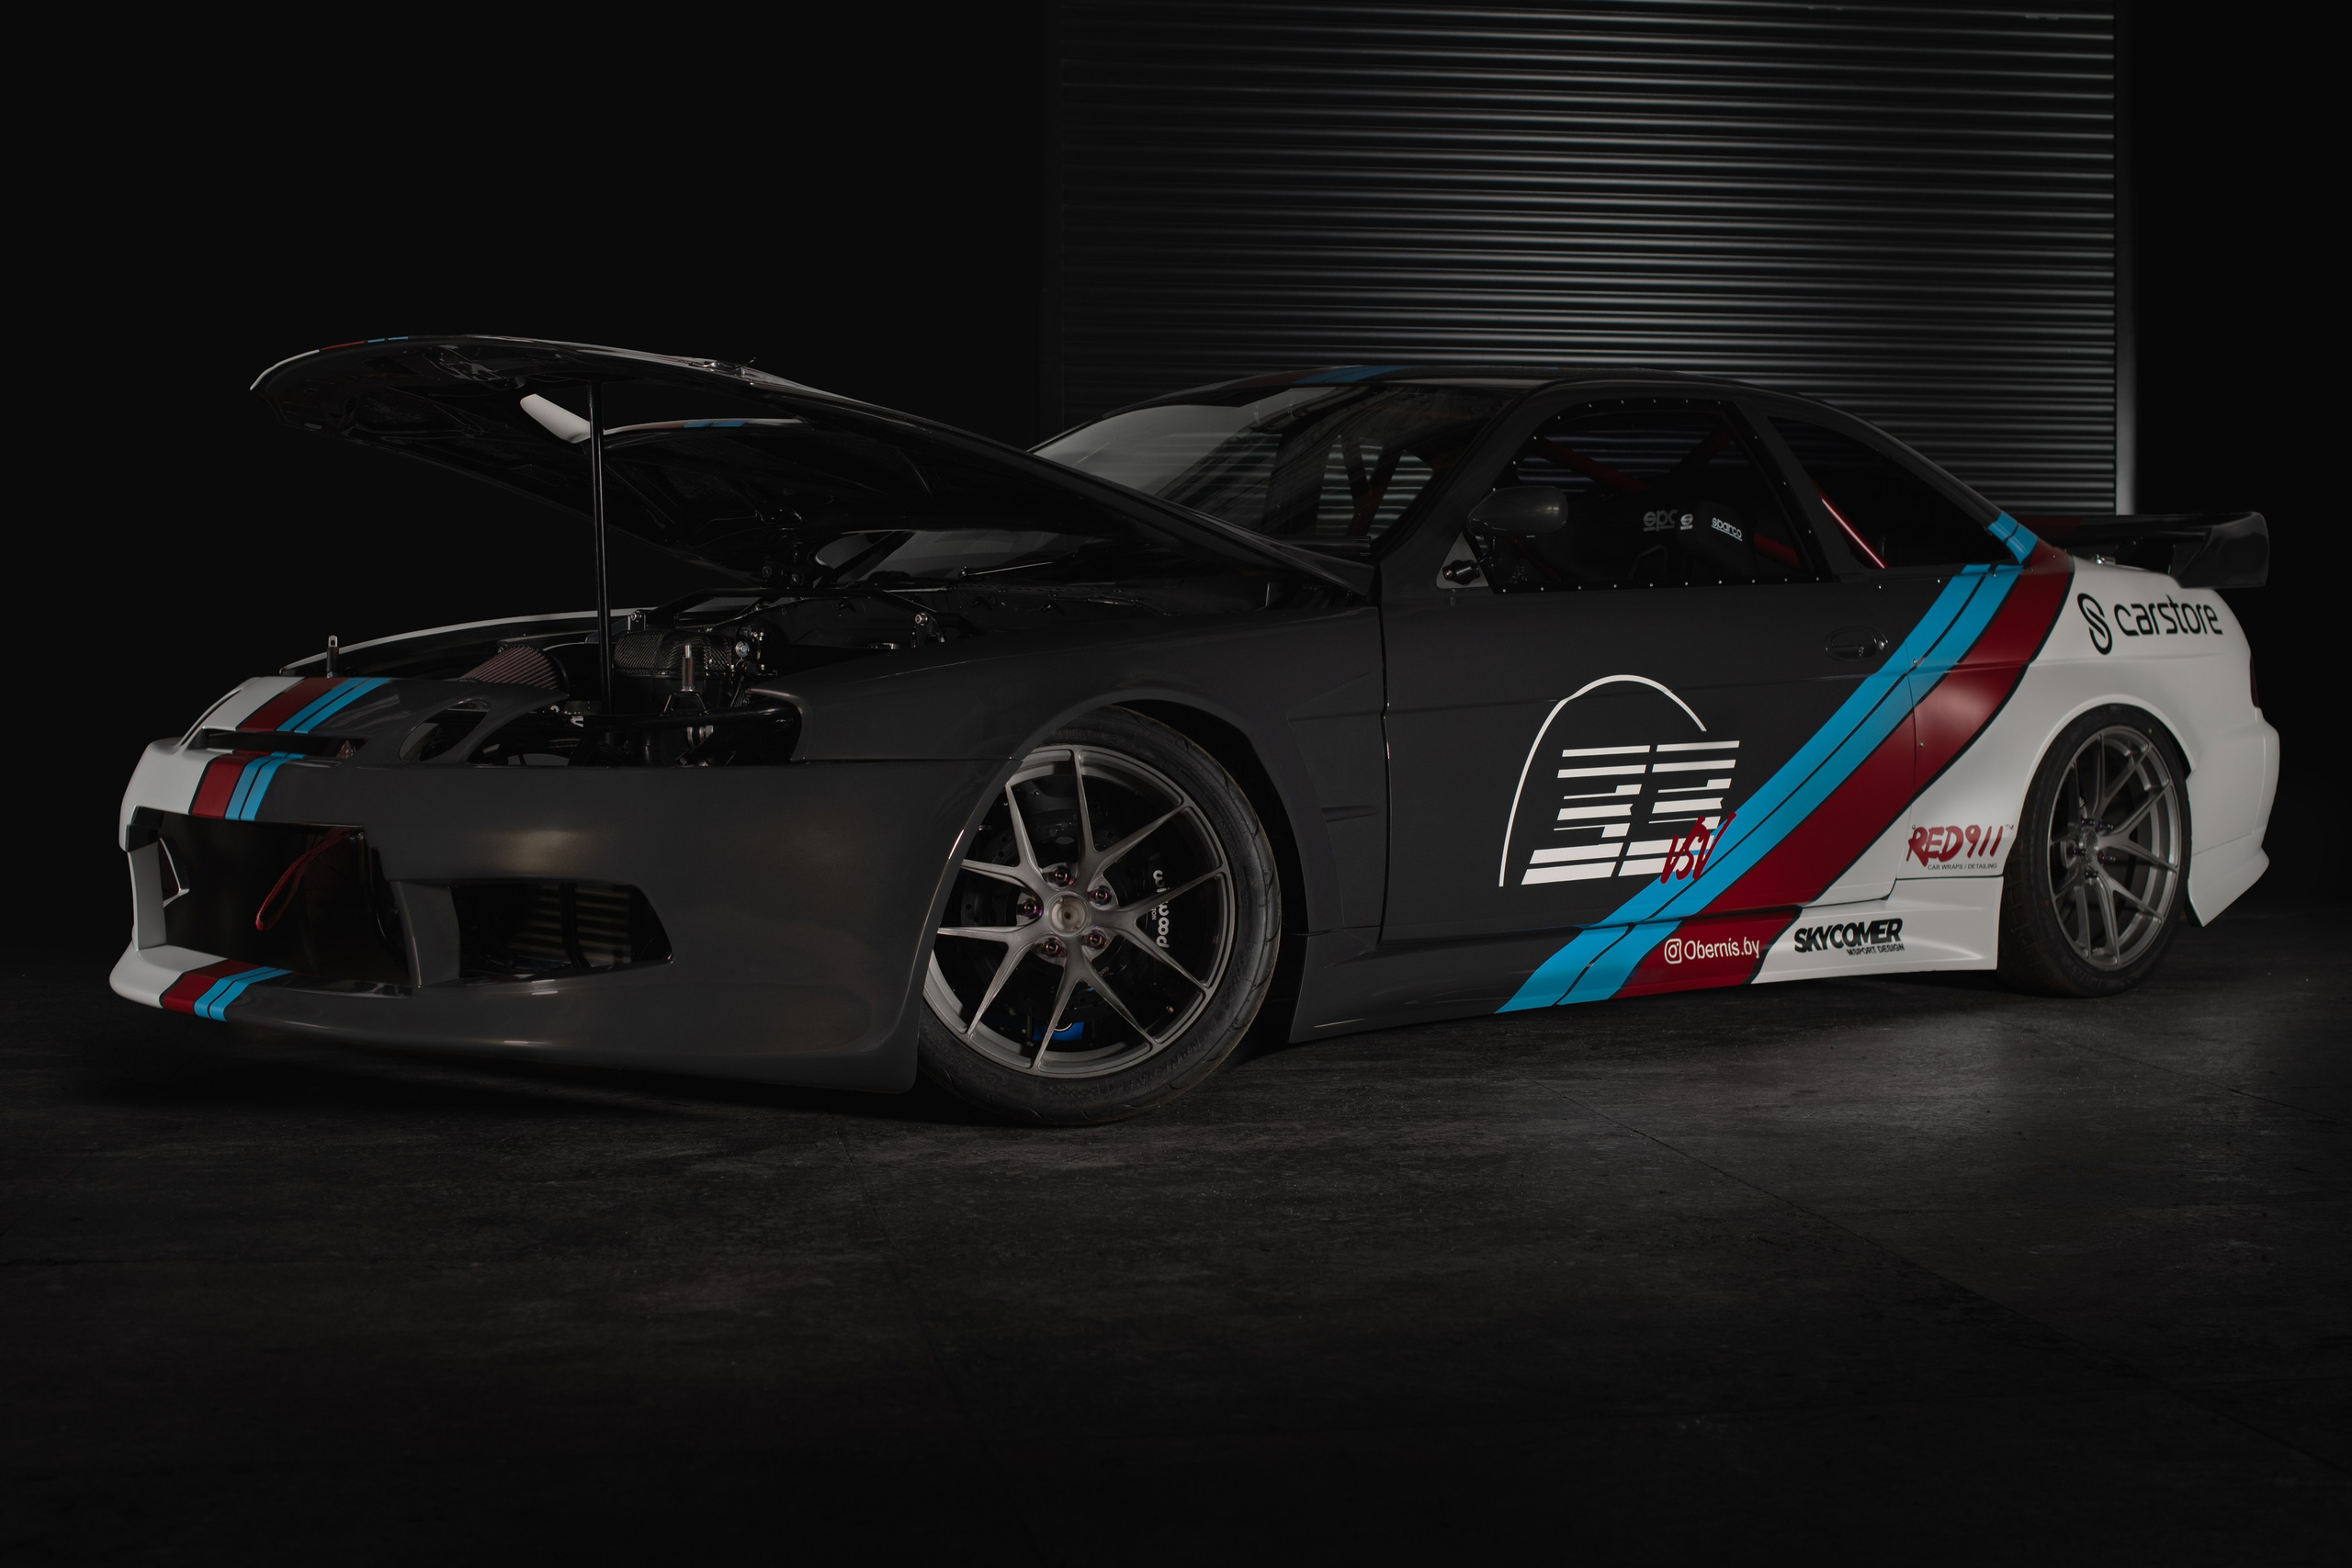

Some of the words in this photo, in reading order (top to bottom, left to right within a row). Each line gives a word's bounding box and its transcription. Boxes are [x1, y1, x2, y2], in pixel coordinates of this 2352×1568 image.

[1711, 516, 1743, 542] sparco
[2114, 593, 2223, 636] carstore
[1152, 869, 1170, 949] wiwood
[1683, 935, 1760, 960] Obernis.by
[1793, 918, 1904, 953] SKYCOMER
[1877, 943, 1905, 954] DESIGN
